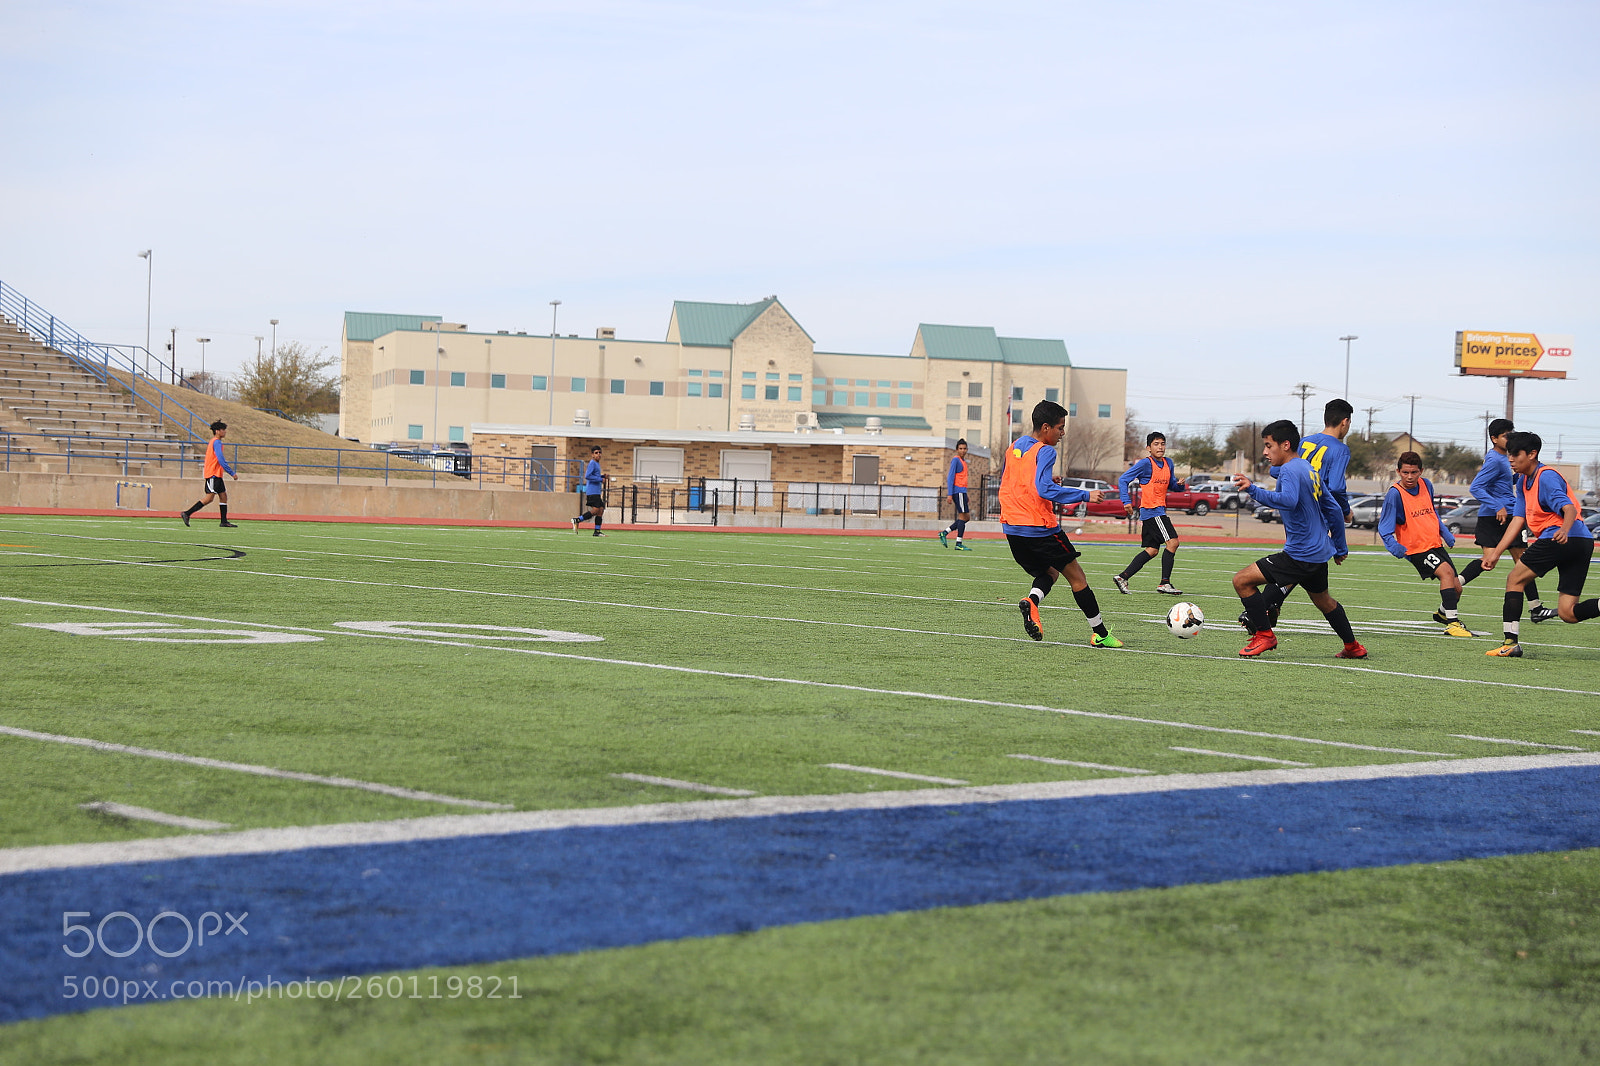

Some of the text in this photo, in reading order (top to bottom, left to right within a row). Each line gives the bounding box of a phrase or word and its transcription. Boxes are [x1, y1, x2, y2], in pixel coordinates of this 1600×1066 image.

[1466, 333, 1531, 344] Bringing Texans
[1467, 342, 1538, 358] low prices
[1423, 553, 1441, 570] 13
